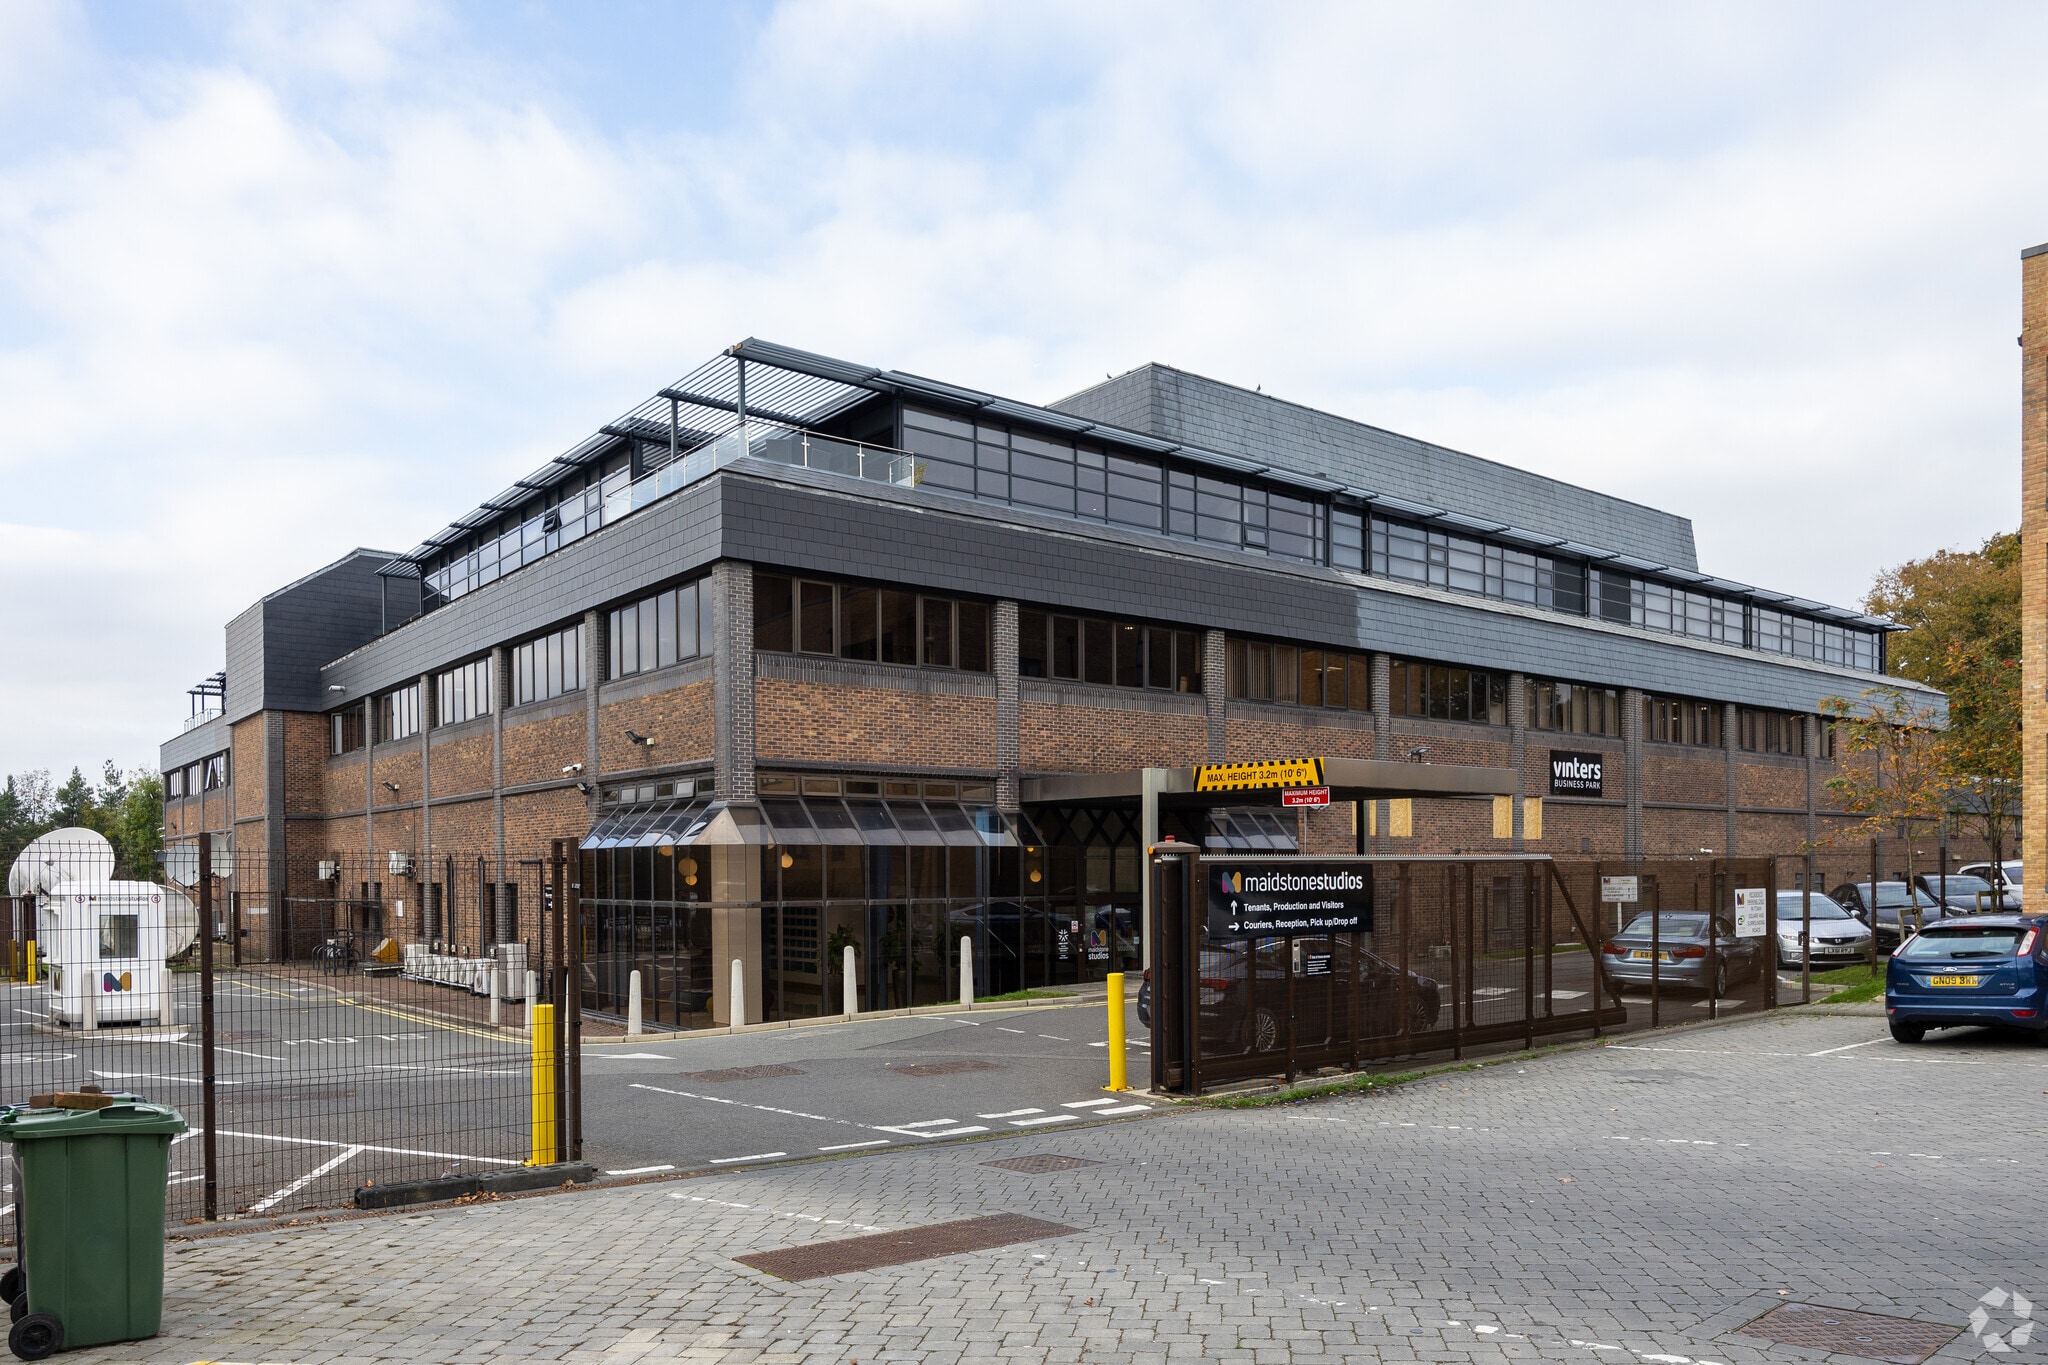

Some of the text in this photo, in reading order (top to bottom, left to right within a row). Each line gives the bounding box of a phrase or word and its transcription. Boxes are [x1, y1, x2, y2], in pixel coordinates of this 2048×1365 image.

[1554, 757, 1600, 779] vinters
[1208, 774, 1225, 782] MAX.
[1228, 772, 1257, 780] HEIGHT
[1259, 770, 1278, 780] 3.2m
[1554, 779, 1600, 789] BUSINESS PARK
[1245, 872, 1363, 892] maidstonestudios
[1244, 903, 1272, 912] Tenants,
[1274, 902, 1308, 910] Production
[1322, 901, 1344, 909] Visitors
[1244, 920, 1274, 930] Couriers,
[1276, 920, 1309, 929] Reception,
[1310, 918, 1323, 926] Pick
[1325, 917, 1349, 927] up/Drop
[1933, 976, 1956, 984] GN09
